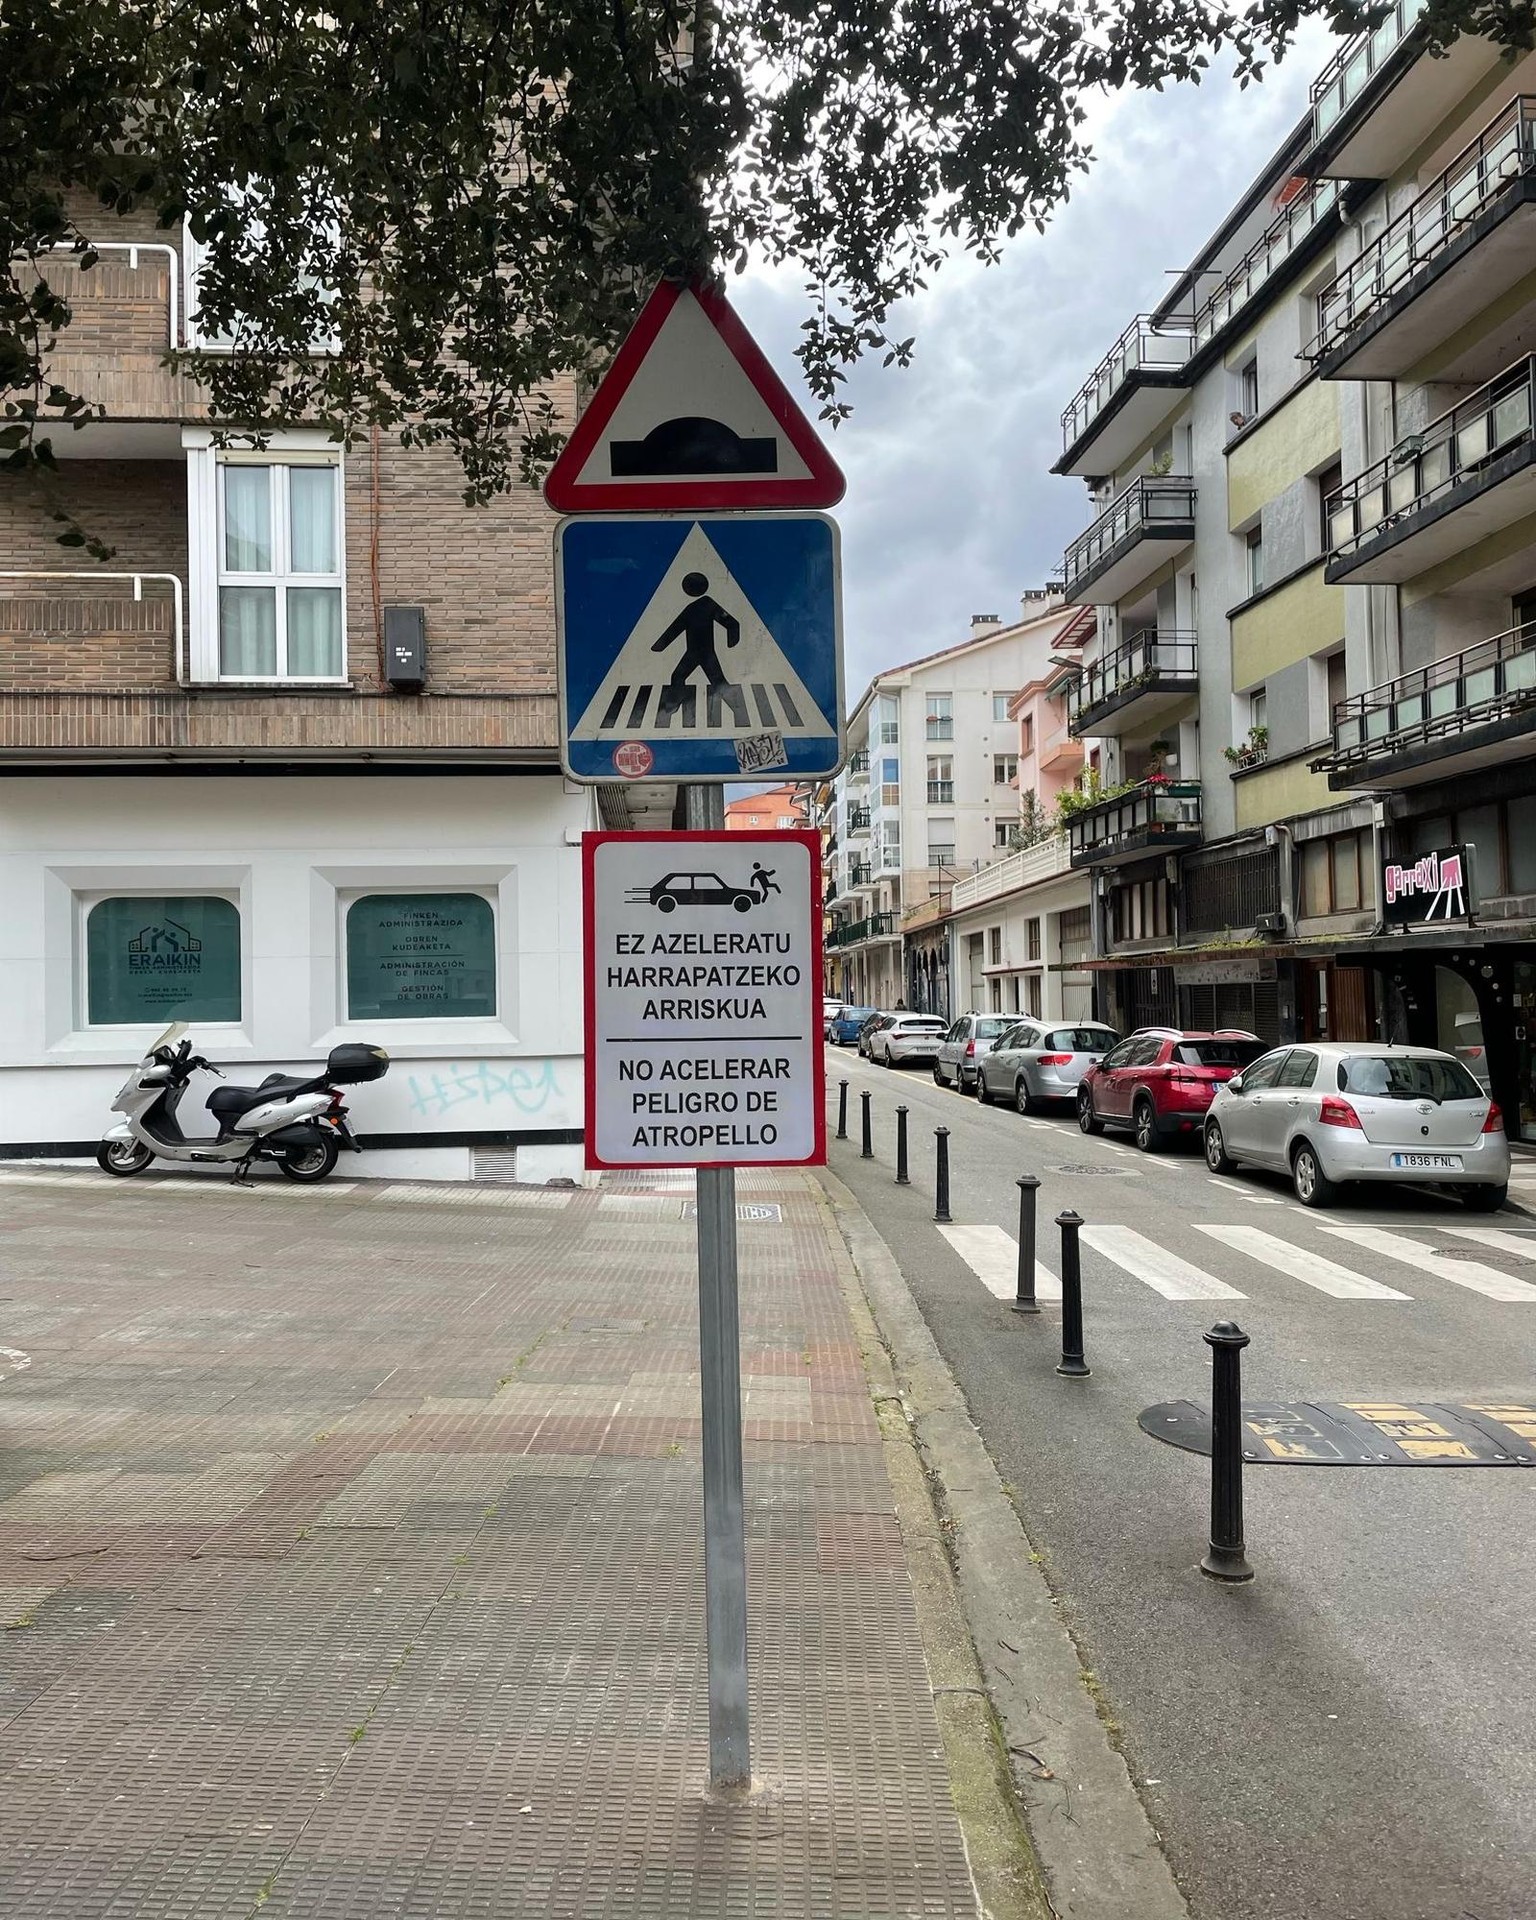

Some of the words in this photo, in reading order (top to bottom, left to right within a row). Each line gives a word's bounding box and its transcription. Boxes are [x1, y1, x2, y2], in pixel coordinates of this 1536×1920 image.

[403, 912, 439, 920] FINKEN
[405, 935, 438, 943] OBREN
[616, 934, 645, 955] EZ
[651, 933, 791, 955] AZELERATU
[392, 943, 451, 951] KUDEAKETA
[129, 954, 201, 966] ERAIKIN
[380, 960, 465, 970] ADMINISTRACIÓN
[607, 965, 801, 988] HARRAPATZEKO
[401, 984, 444, 992] GESTIÓN
[415, 992, 449, 1000] OBRAS
[642, 998, 767, 1020] ARRISKUA
[619, 1060, 654, 1081] NO
[659, 1058, 791, 1080] ACELERAR
[632, 1091, 739, 1114] PELIGRO
[746, 1091, 778, 1112] DE
[632, 1123, 778, 1147] ATROPELLO
[1404, 1155, 1431, 1166] 1836
[1434, 1156, 1456, 1168] FNL
